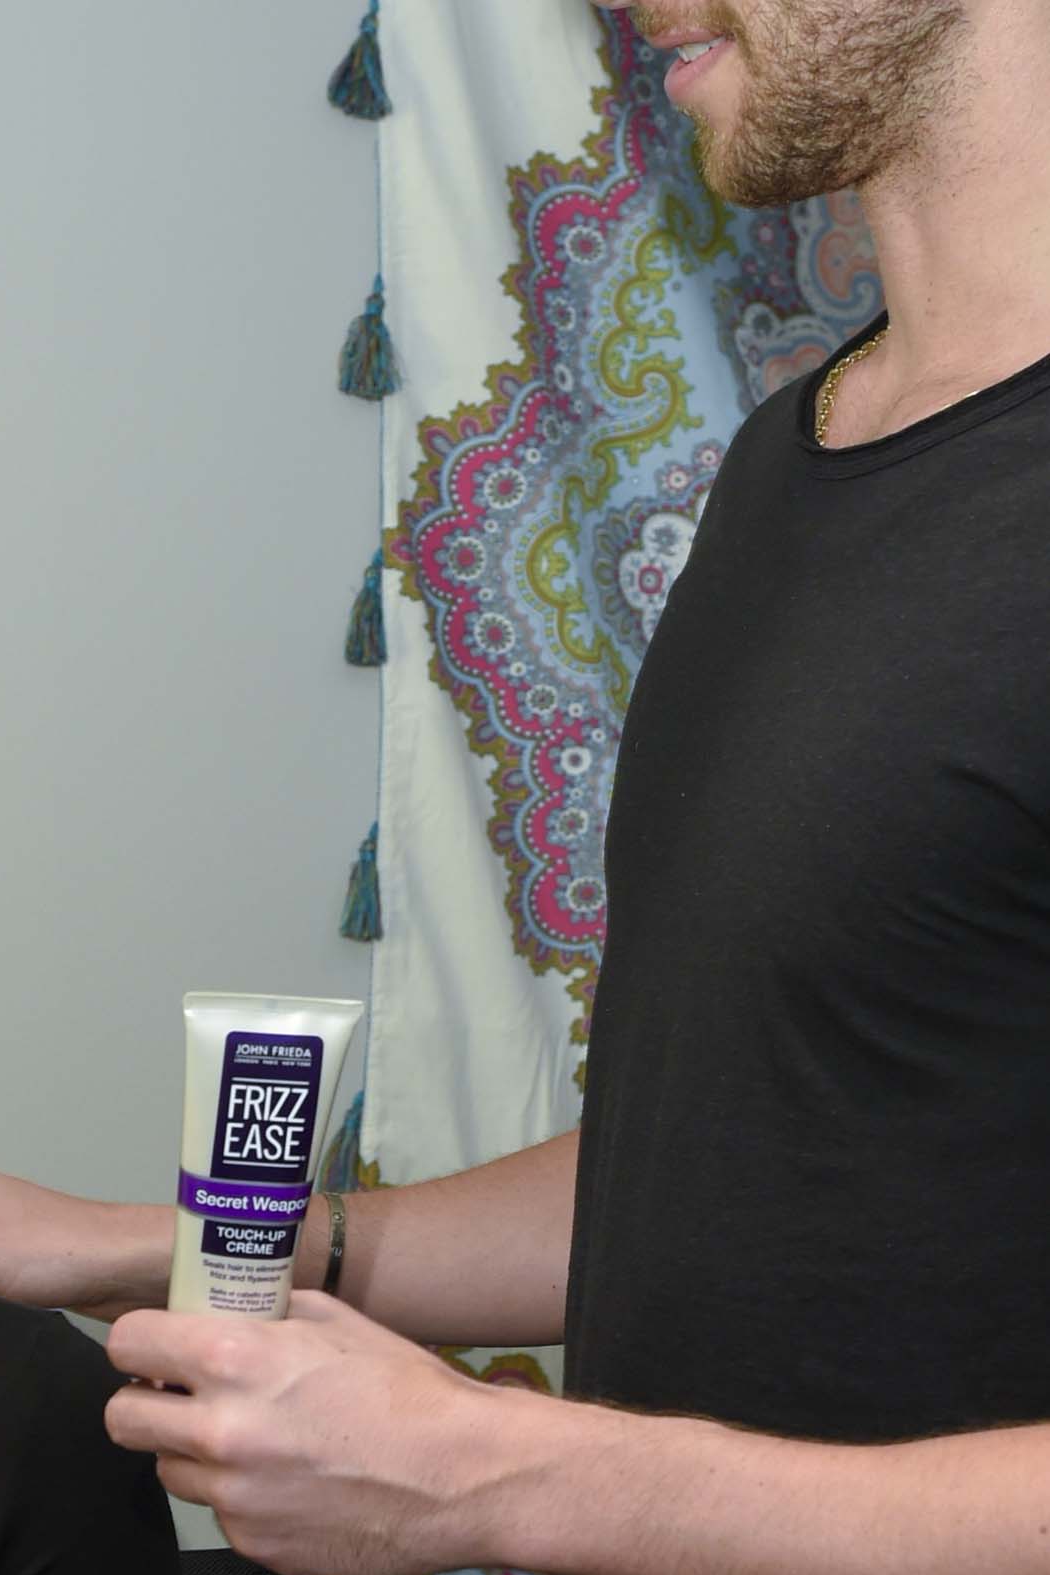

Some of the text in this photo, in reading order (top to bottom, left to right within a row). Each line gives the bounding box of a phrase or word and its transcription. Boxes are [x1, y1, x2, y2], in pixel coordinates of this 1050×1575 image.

[236, 1044, 311, 1057] JOHN FRIEDA
[227, 1085, 309, 1123] FRIZZ
[195, 1189, 248, 1209] Secret
[217, 1226, 286, 1241] TOUCH-UP
